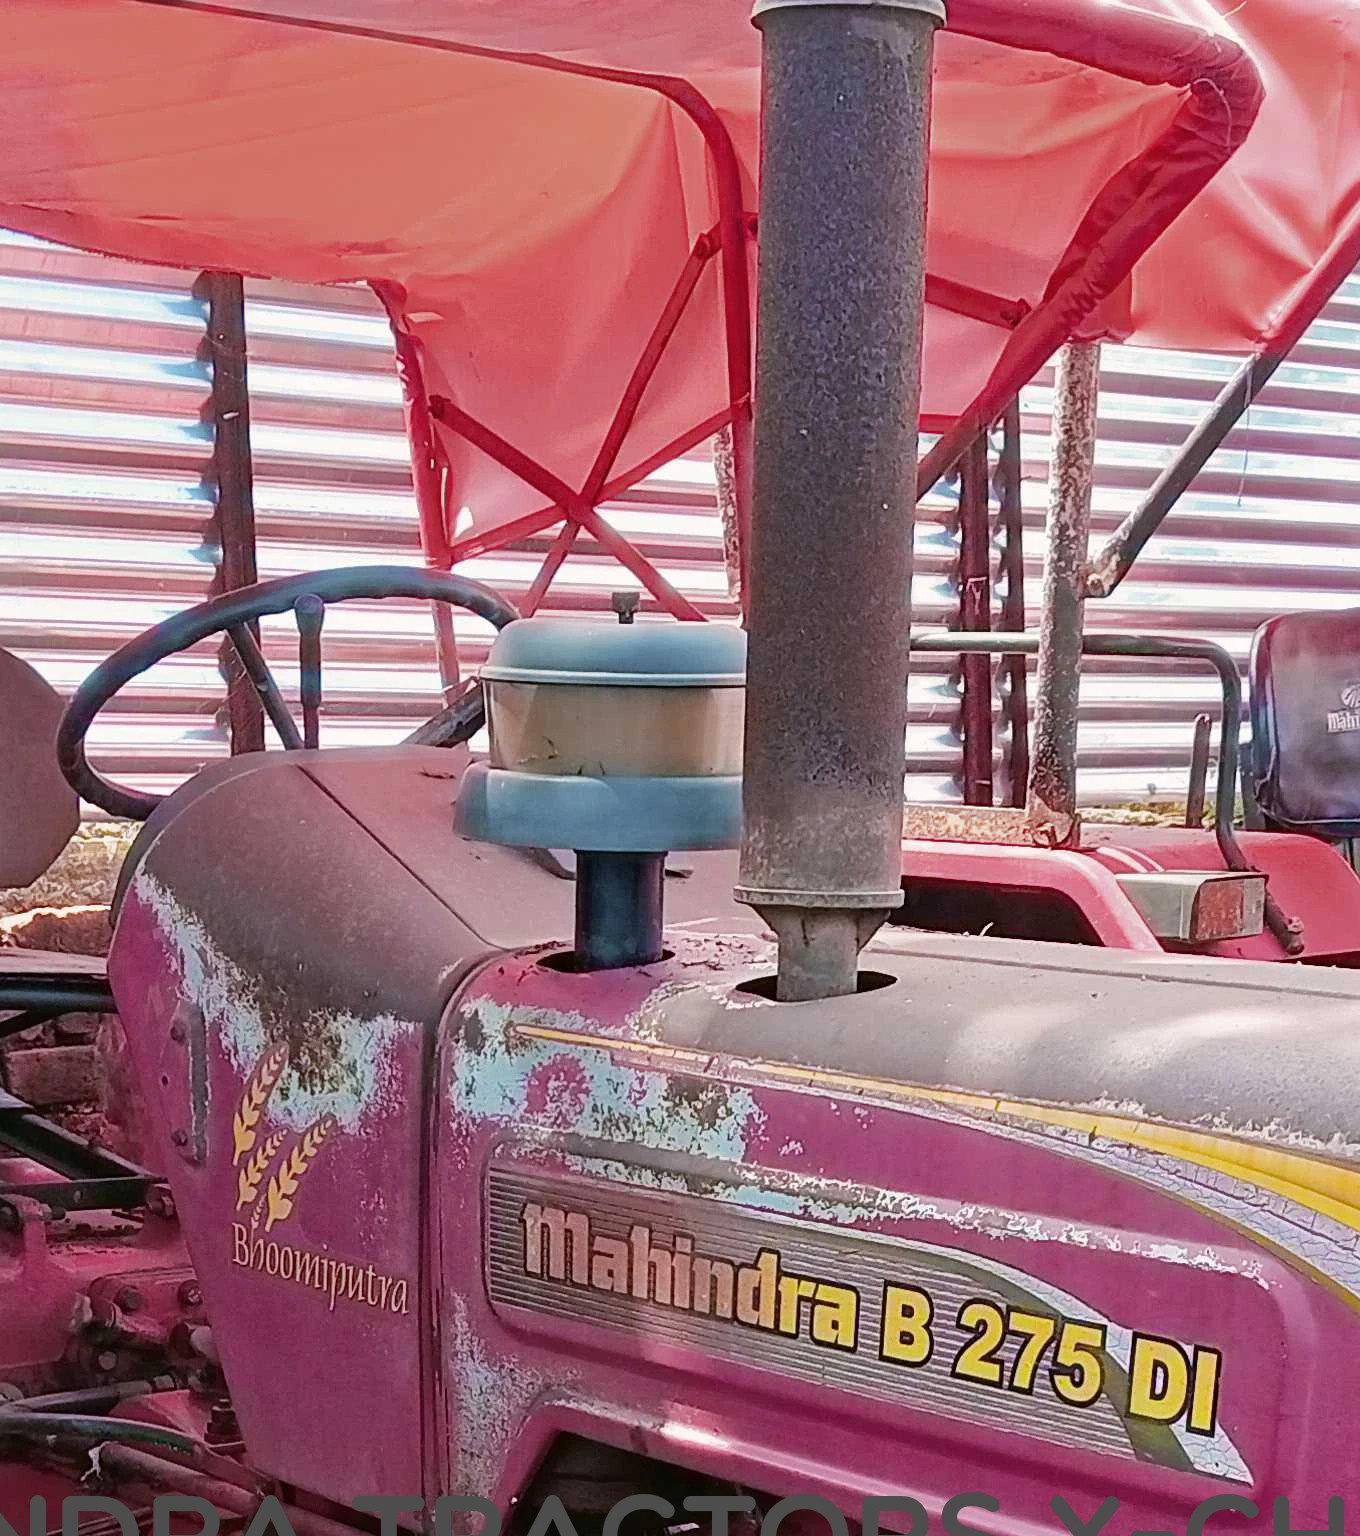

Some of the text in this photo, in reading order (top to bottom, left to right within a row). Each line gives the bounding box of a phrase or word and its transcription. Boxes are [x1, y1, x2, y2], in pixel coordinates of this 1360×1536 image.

[232, 1221, 410, 1315] Bhoomiputra
[520, 1200, 1223, 1438] Mahindra B 275 DI
